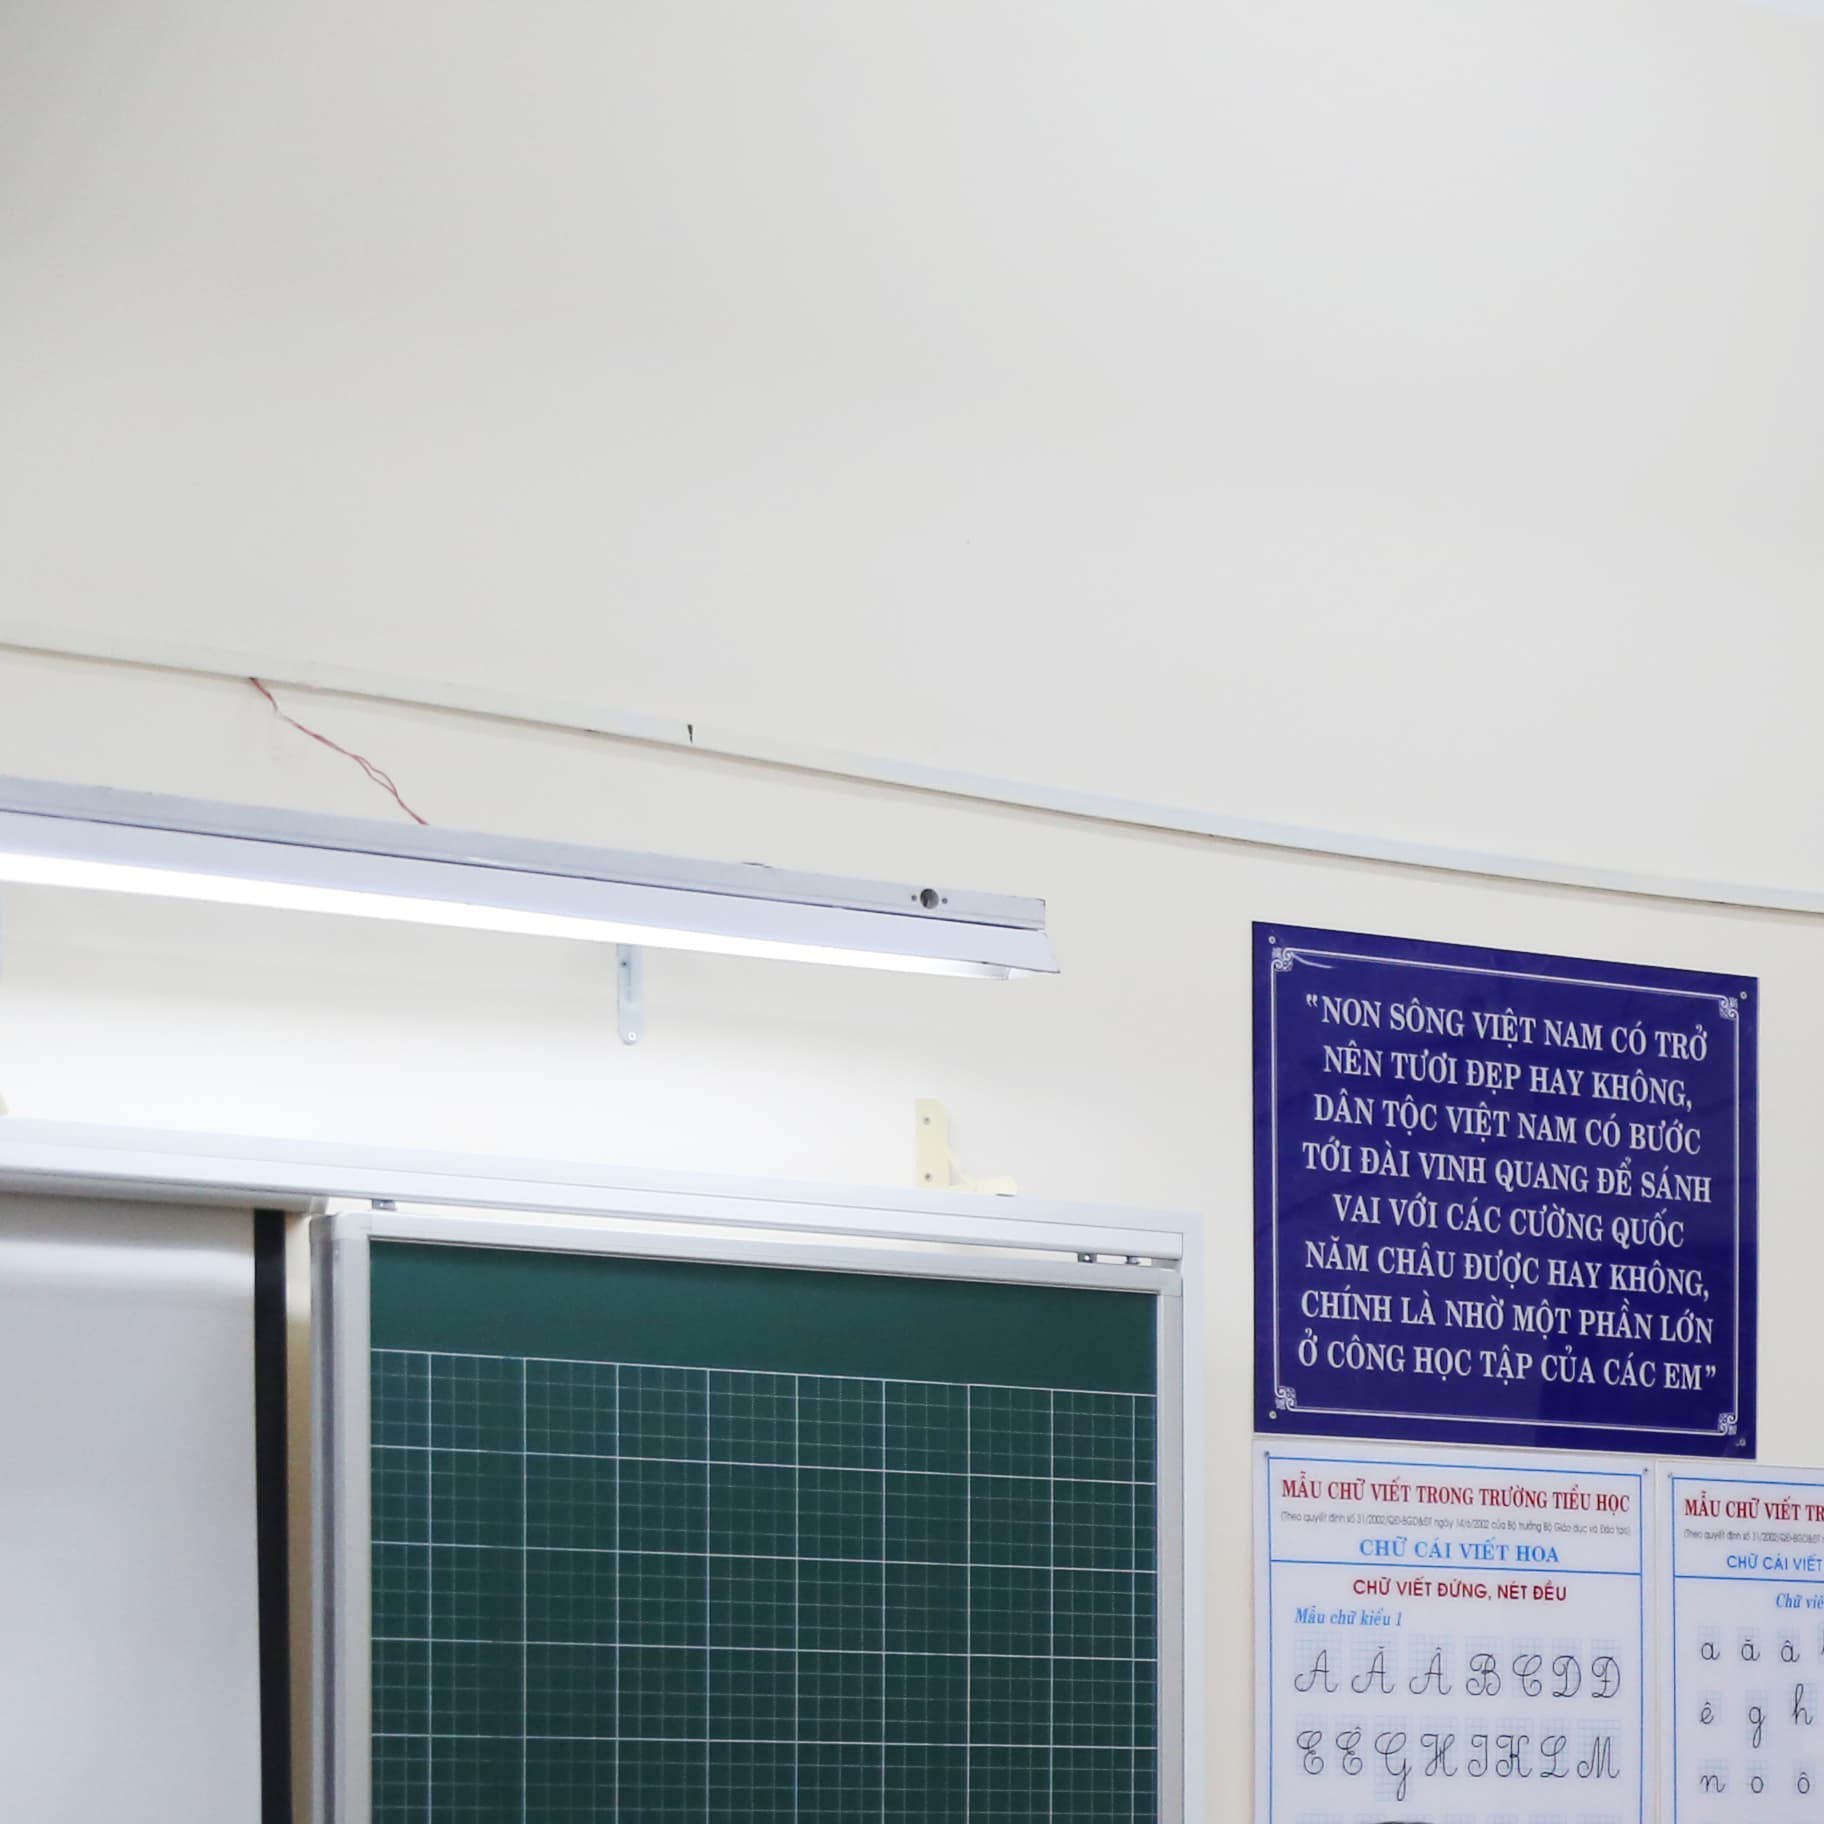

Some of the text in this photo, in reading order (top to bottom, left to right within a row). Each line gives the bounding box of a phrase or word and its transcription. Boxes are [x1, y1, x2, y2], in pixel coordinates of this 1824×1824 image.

[1389, 997, 1465, 1037] SÔNG
[1471, 1007, 1537, 1049] VIỆT
[1543, 1019, 1603, 1051] NAM
[1610, 1020, 1647, 1056] CÓ
[1654, 1024, 1708, 1062] TRỞ
[1323, 1039, 1692, 1113] NÊN TƯƠI ĐẸP HAY KHÔNG,
[1313, 1087, 1701, 1155] DÂN TỘC VIỆT NAM CÓ BƯỚC
[1302, 1139, 1712, 1203] TỚI ĐÀI VINH QUANG ĐỂ SÁNH
[1332, 1191, 1684, 1250] VAI VỚI CÁC CƯỜNG QUỐC
[1304, 1235, 1709, 1305] NĂM CHÂU ĐƯỢC HAY KHÔNG,
[1301, 1284, 1714, 1344] CHÍNH LÀ NHỜ MỘT PHẦN LỚN
[1297, 1327, 1318, 1367] Ở
[1326, 1334, 1406, 1373] CÔNG
[1413, 1346, 1472, 1382] HỌC
[1479, 1343, 1533, 1387] TẬP
[1540, 1345, 1596, 1384] CỦA
[1603, 1351, 1656, 1388] CÁC
[1281, 1471, 1630, 1516] MẪU CHỮ VIẾT TRONG TRƯỜNG TIỂU HỌC
[1684, 1490, 1721, 1518] MẪU
[1725, 1498, 1761, 1520] CHỮ
[1763, 1495, 1802, 1521] VIẾT
[1359, 1535, 1559, 1563] CHỮ CÁI VIẾT HOA
[1726, 1553, 1759, 1570] CHỮ
[1792, 1552, 1823, 1572] VIẾT
[1352, 1577, 1392, 1596] CHỮ
[1395, 1576, 1433, 1597] VIẾT
[1436, 1578, 1492, 1601] ĐỨNG,
[1496, 1581, 1528, 1600] NÉT
[1293, 1648, 1338, 1693] A
[1465, 1653, 1502, 1697] B
[1511, 1653, 1543, 1698] C
[1551, 1654, 1582, 1698] D
[1700, 1641, 1721, 1661] a
[1780, 1640, 1801, 1663] â
[1296, 1726, 1620, 1802] E Ê G H I K L M
